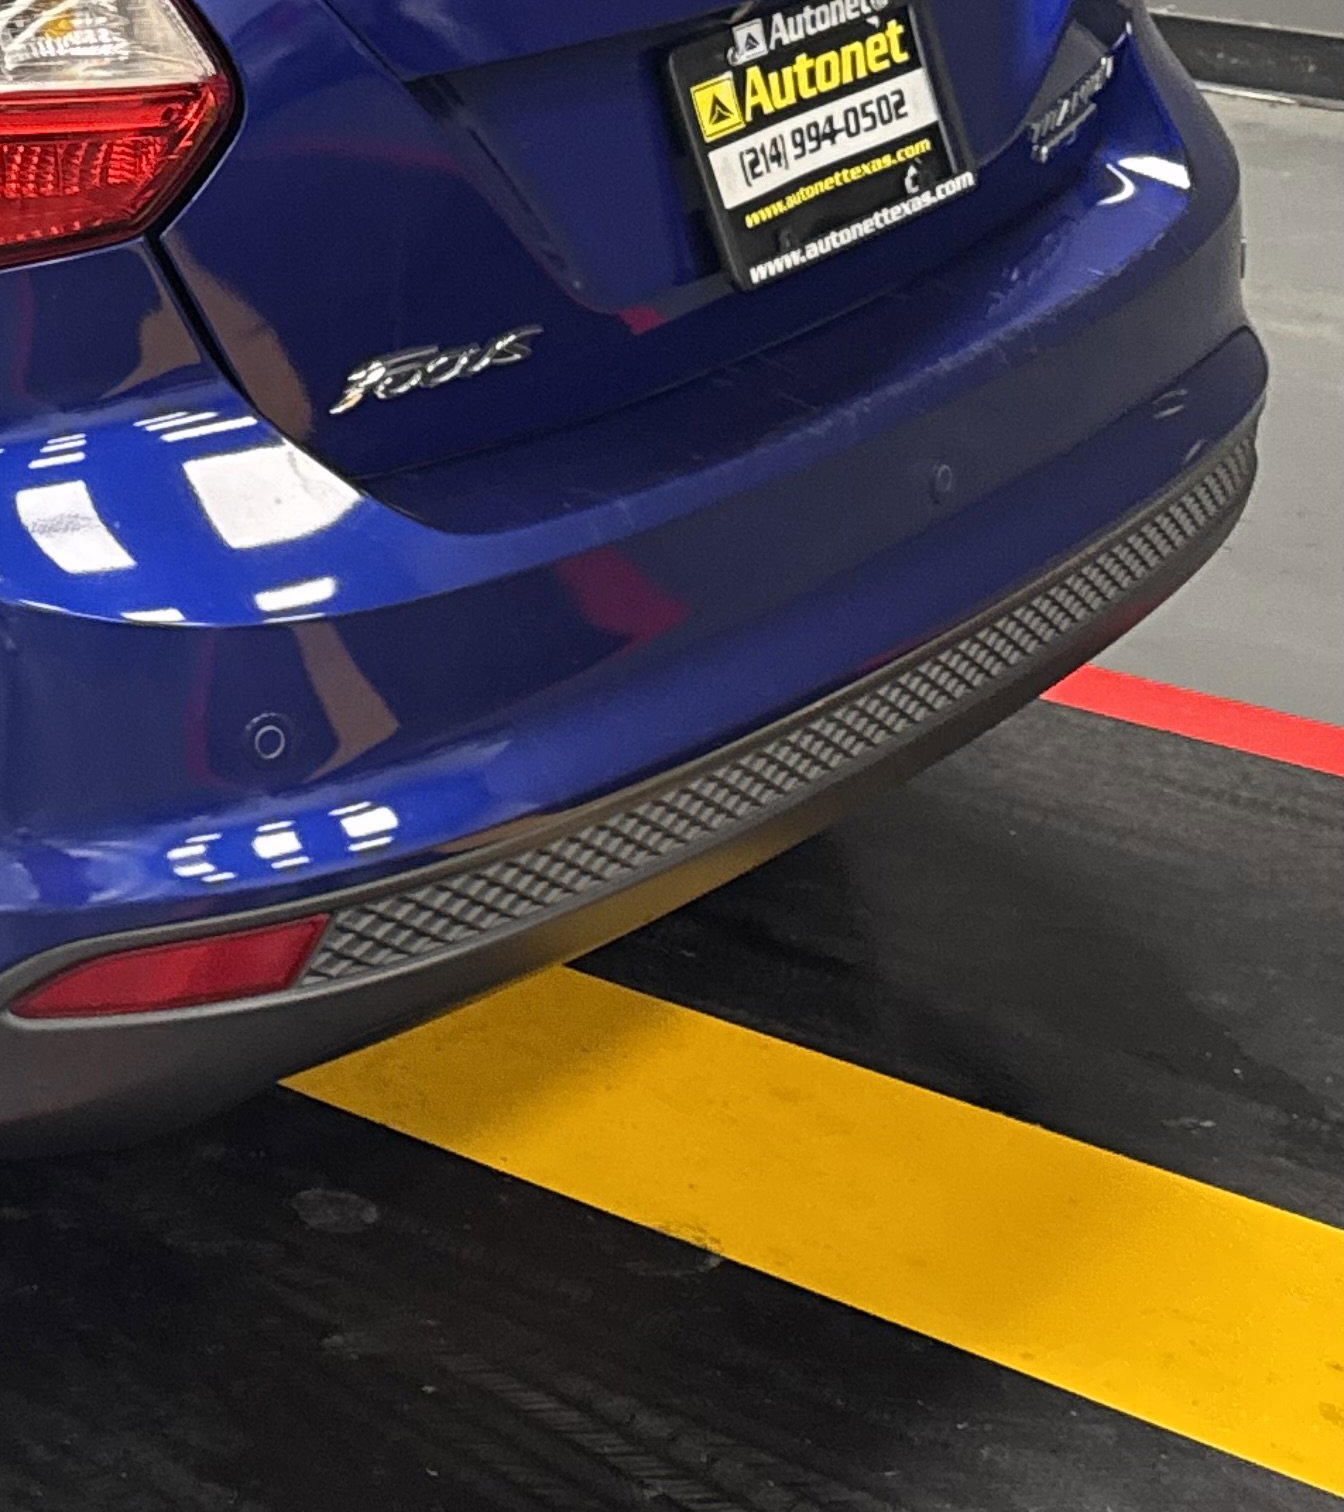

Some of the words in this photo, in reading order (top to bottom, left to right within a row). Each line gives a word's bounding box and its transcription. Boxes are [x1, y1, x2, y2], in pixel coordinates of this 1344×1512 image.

[745, 18, 910, 122] Autonet
[739, 135, 789, 187] (214)
[791, 89, 908, 160] 994-0502
[745, 139, 931, 228] www.autonettexas.com
[750, 172, 975, 284] www.autonettexas.com
[328, 325, 544, 414] Focus
